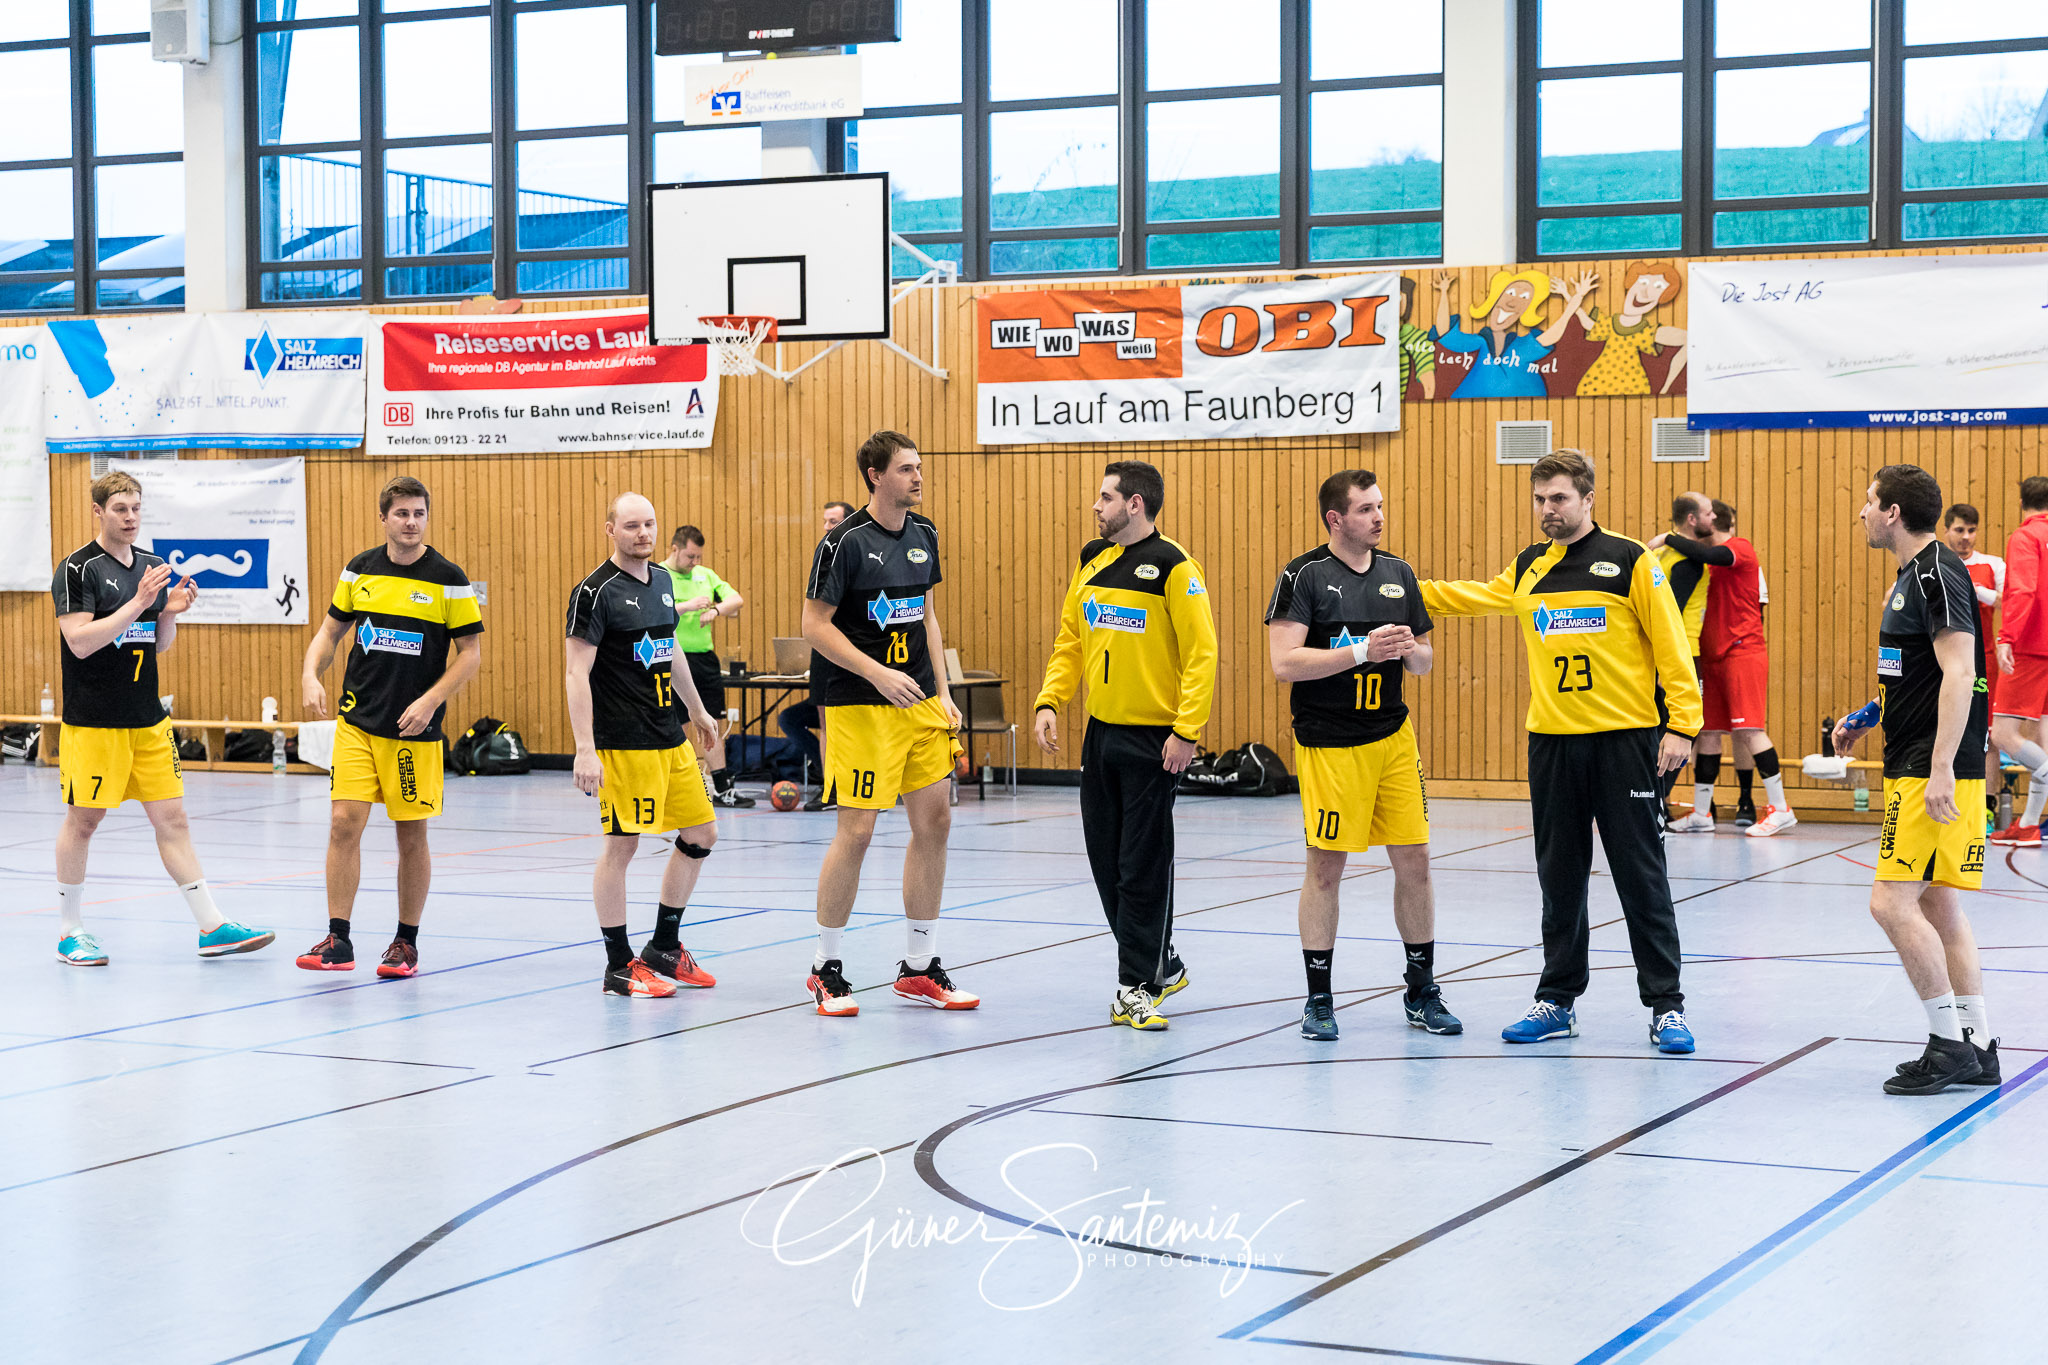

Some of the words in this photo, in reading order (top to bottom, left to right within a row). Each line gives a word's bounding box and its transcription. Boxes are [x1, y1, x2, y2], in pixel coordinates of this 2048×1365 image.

[1722, 282, 1744, 303] Die
[1752, 282, 1791, 302] Jost
[1795, 281, 1824, 303] AG
[998, 326, 1031, 343] WIE
[1081, 319, 1130, 337] WAS
[1196, 295, 1390, 357] OBI
[284, 340, 316, 354] SALZ
[434, 331, 590, 354] Reiseservice
[1043, 336, 1073, 352] WO
[1122, 344, 1152, 354] weiß
[285, 354, 360, 370] HELMREICH
[428, 363, 446, 373] Ihre
[449, 362, 493, 375] regionale
[495, 361, 510, 372] DB
[512, 361, 549, 375] Agentur
[551, 360, 563, 371] im
[565, 358, 604, 370] Bahnhof
[604, 356, 625, 369] Lauf
[626, 355, 656, 367] rechts
[1483, 349, 1520, 368] doch
[1527, 358, 1557, 373] mal
[388, 406, 410, 423] DB
[426, 408, 453, 420] Ihre
[458, 406, 499, 419] Profis
[505, 406, 524, 418] für
[531, 405, 570, 418] Bahn
[576, 403, 605, 416] und
[612, 401, 671, 415] Reisen!
[991, 395, 1020, 427] In
[1034, 393, 1108, 425] Lauf
[1119, 398, 1170, 423] am
[1185, 387, 1354, 424] Faunberg
[1371, 381, 1383, 414] 1
[1868, 410, 2008, 425] www.jost-ag.com
[387, 435, 431, 445] Telefon:
[434, 435, 468, 445] 09123
[478, 434, 491, 444] 22
[495, 434, 508, 444] 21
[1103, 606, 1117, 615] SALZ
[1554, 610, 1573, 619] SALZ
[1553, 618, 1604, 628] HELMREICH
[378, 638, 420, 650] HELMREICH
[379, 630, 396, 639] SALZ
[133, 649, 144, 682] 7
[1104, 649, 1110, 685] 1
[1554, 654, 1594, 693] 23
[654, 672, 672, 708] 13
[1353, 673, 1382, 711] 10
[398, 757, 408, 796] ROBERT
[405, 755, 417, 796] MEIER
[852, 769, 875, 799] 18
[91, 776, 103, 801] 7
[633, 797, 655, 825] 13
[1316, 808, 1340, 841] 10
[1886, 800, 1902, 851] MEIER
